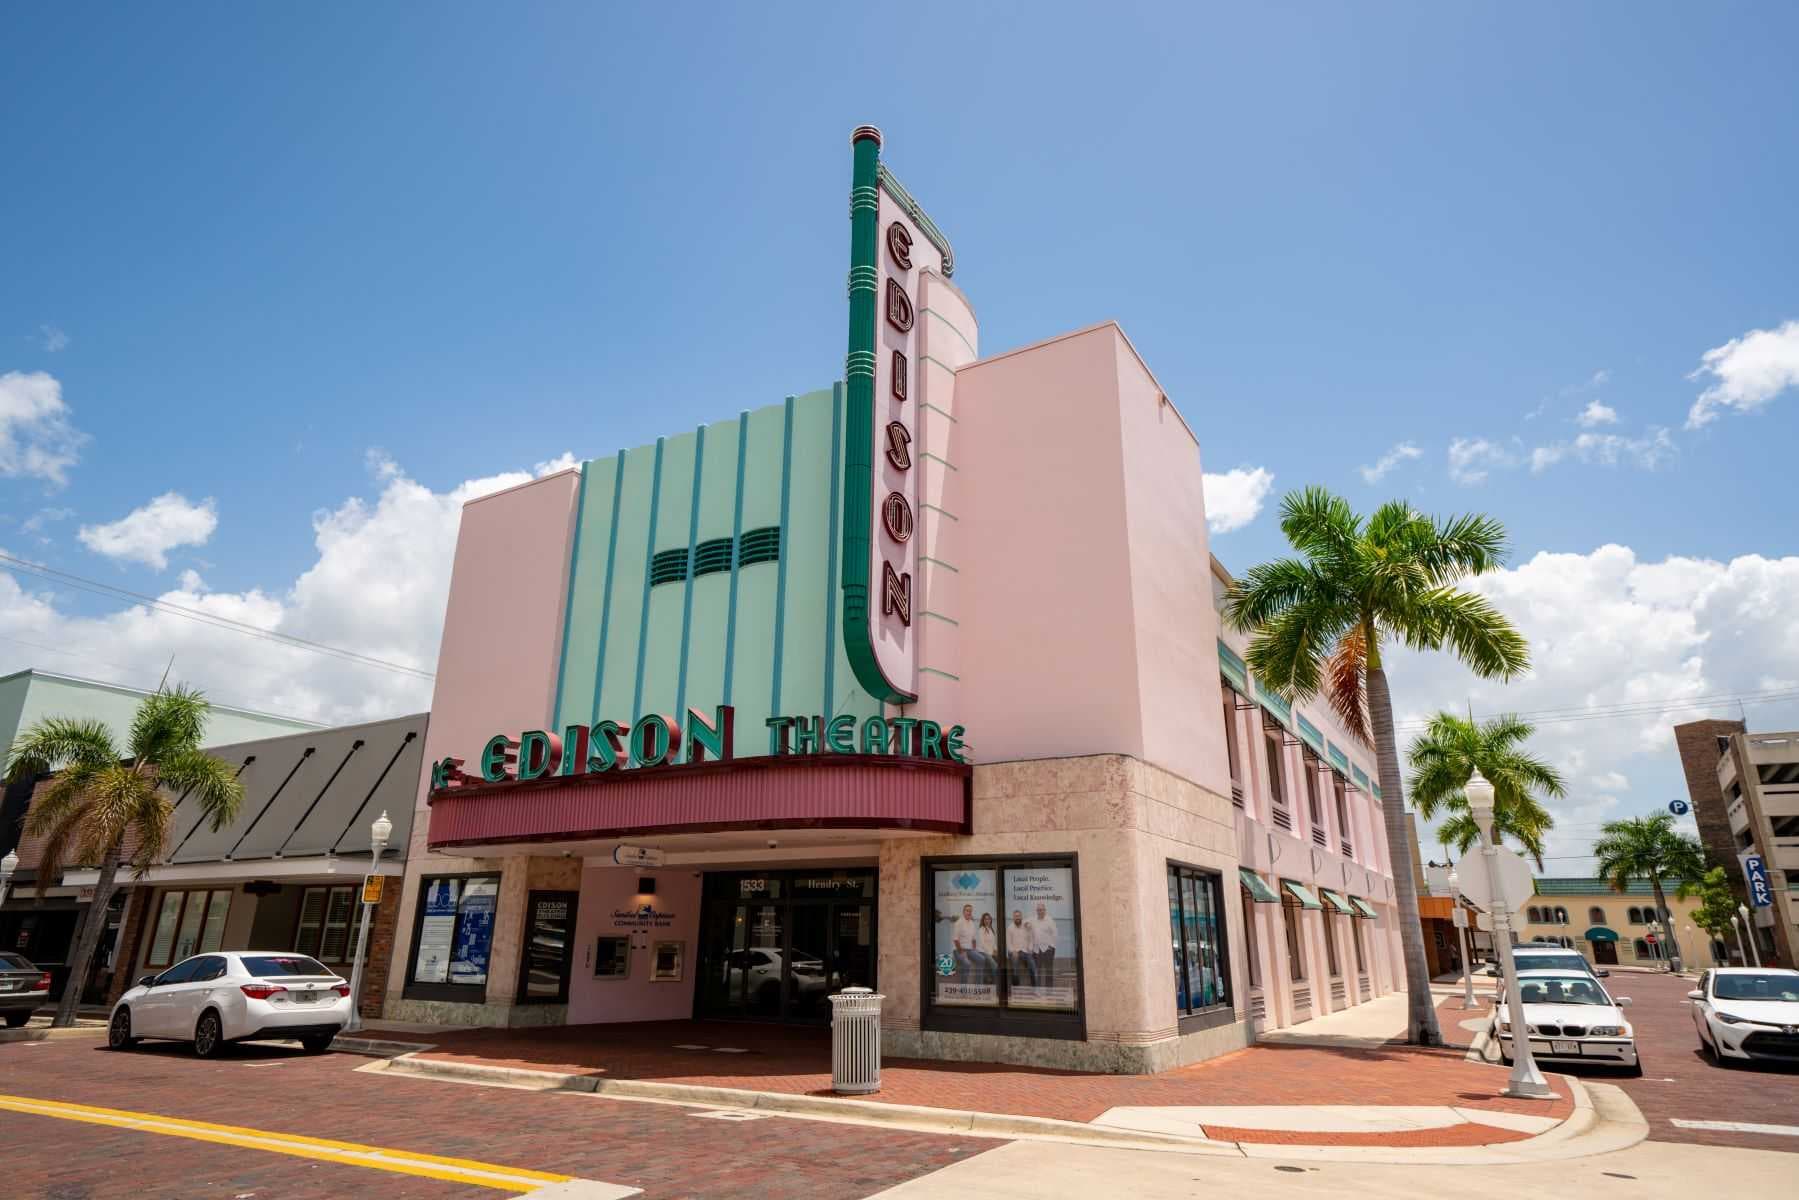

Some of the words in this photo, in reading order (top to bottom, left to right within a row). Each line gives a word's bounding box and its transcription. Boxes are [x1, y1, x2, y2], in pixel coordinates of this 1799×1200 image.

[883, 221, 914, 627] EDISON
[481, 705, 735, 782] EDISON
[765, 714, 966, 765] THEATRE
[1672, 801, 1683, 812] P
[740, 879, 765, 892] 1533
[808, 879, 840, 891] Hendry
[1748, 860, 1771, 904] PARK
